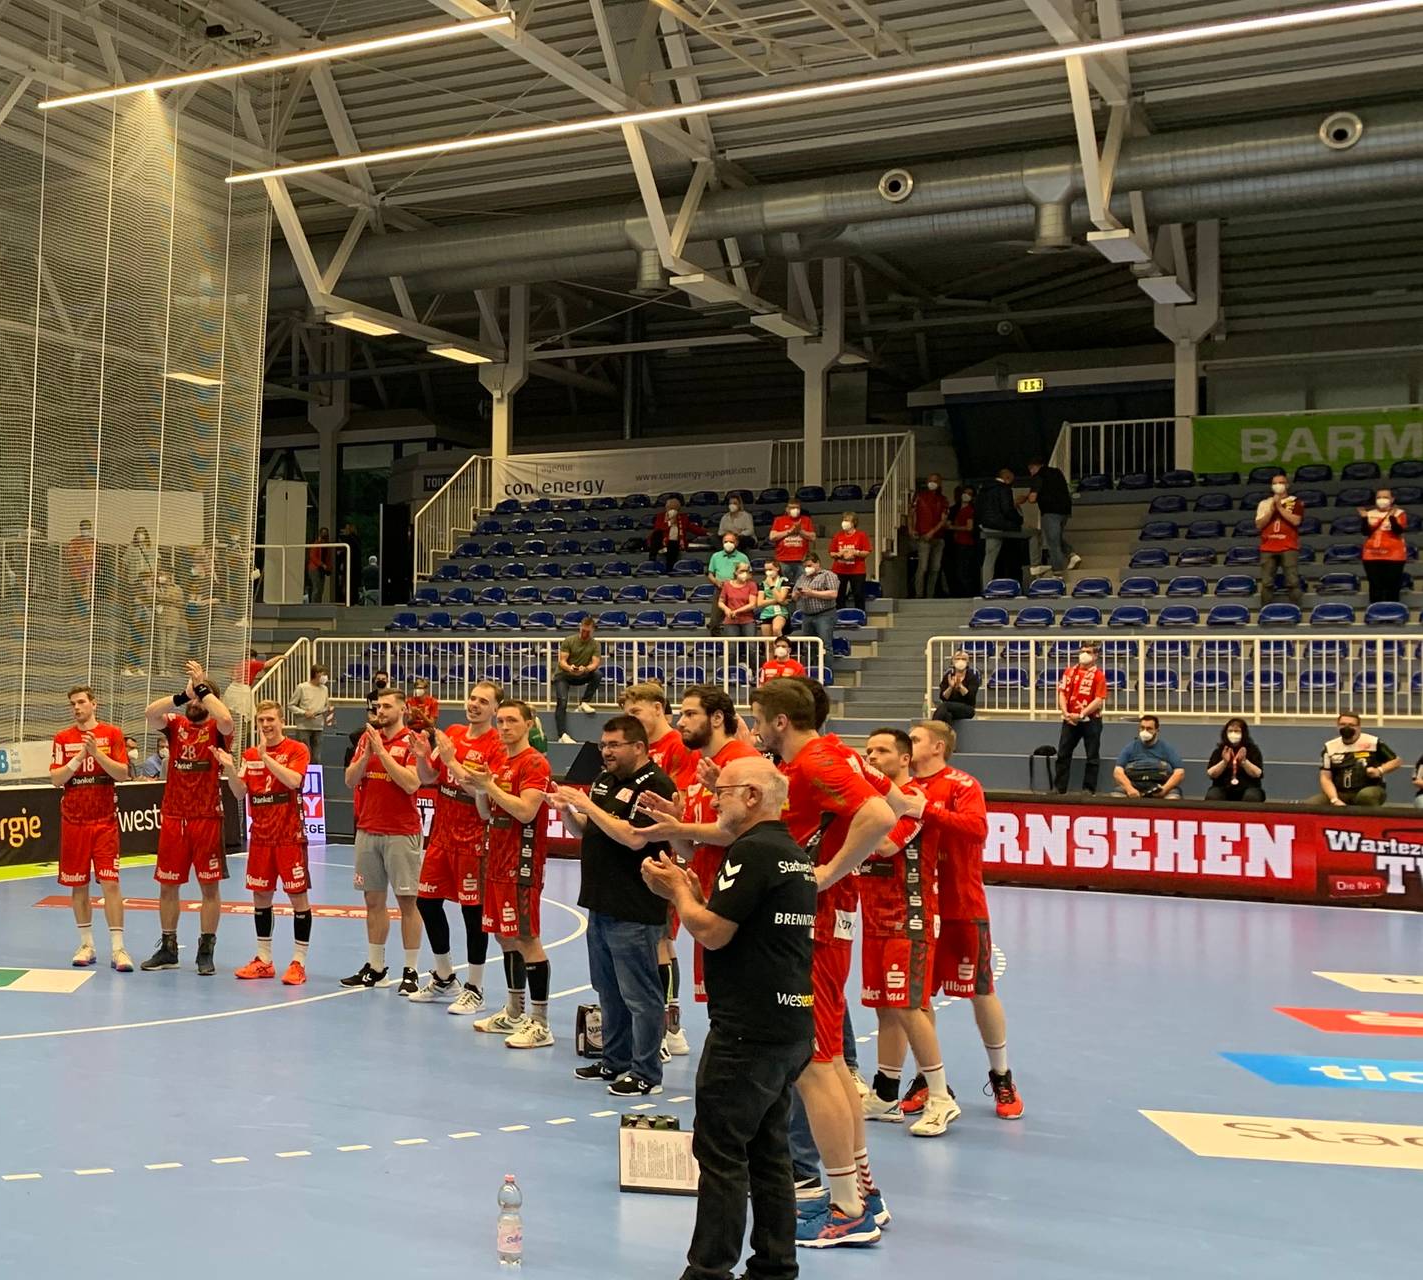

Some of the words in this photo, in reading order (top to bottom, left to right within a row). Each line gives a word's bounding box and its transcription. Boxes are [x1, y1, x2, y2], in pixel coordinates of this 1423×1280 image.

[542, 479, 605, 496] energy
[82, 756, 95, 772] 18
[265, 775, 272, 792] 2
[118, 804, 162, 832] west
[982, 811, 1295, 879] RNSEHEN
[1325, 829, 1423, 855] Wartez
